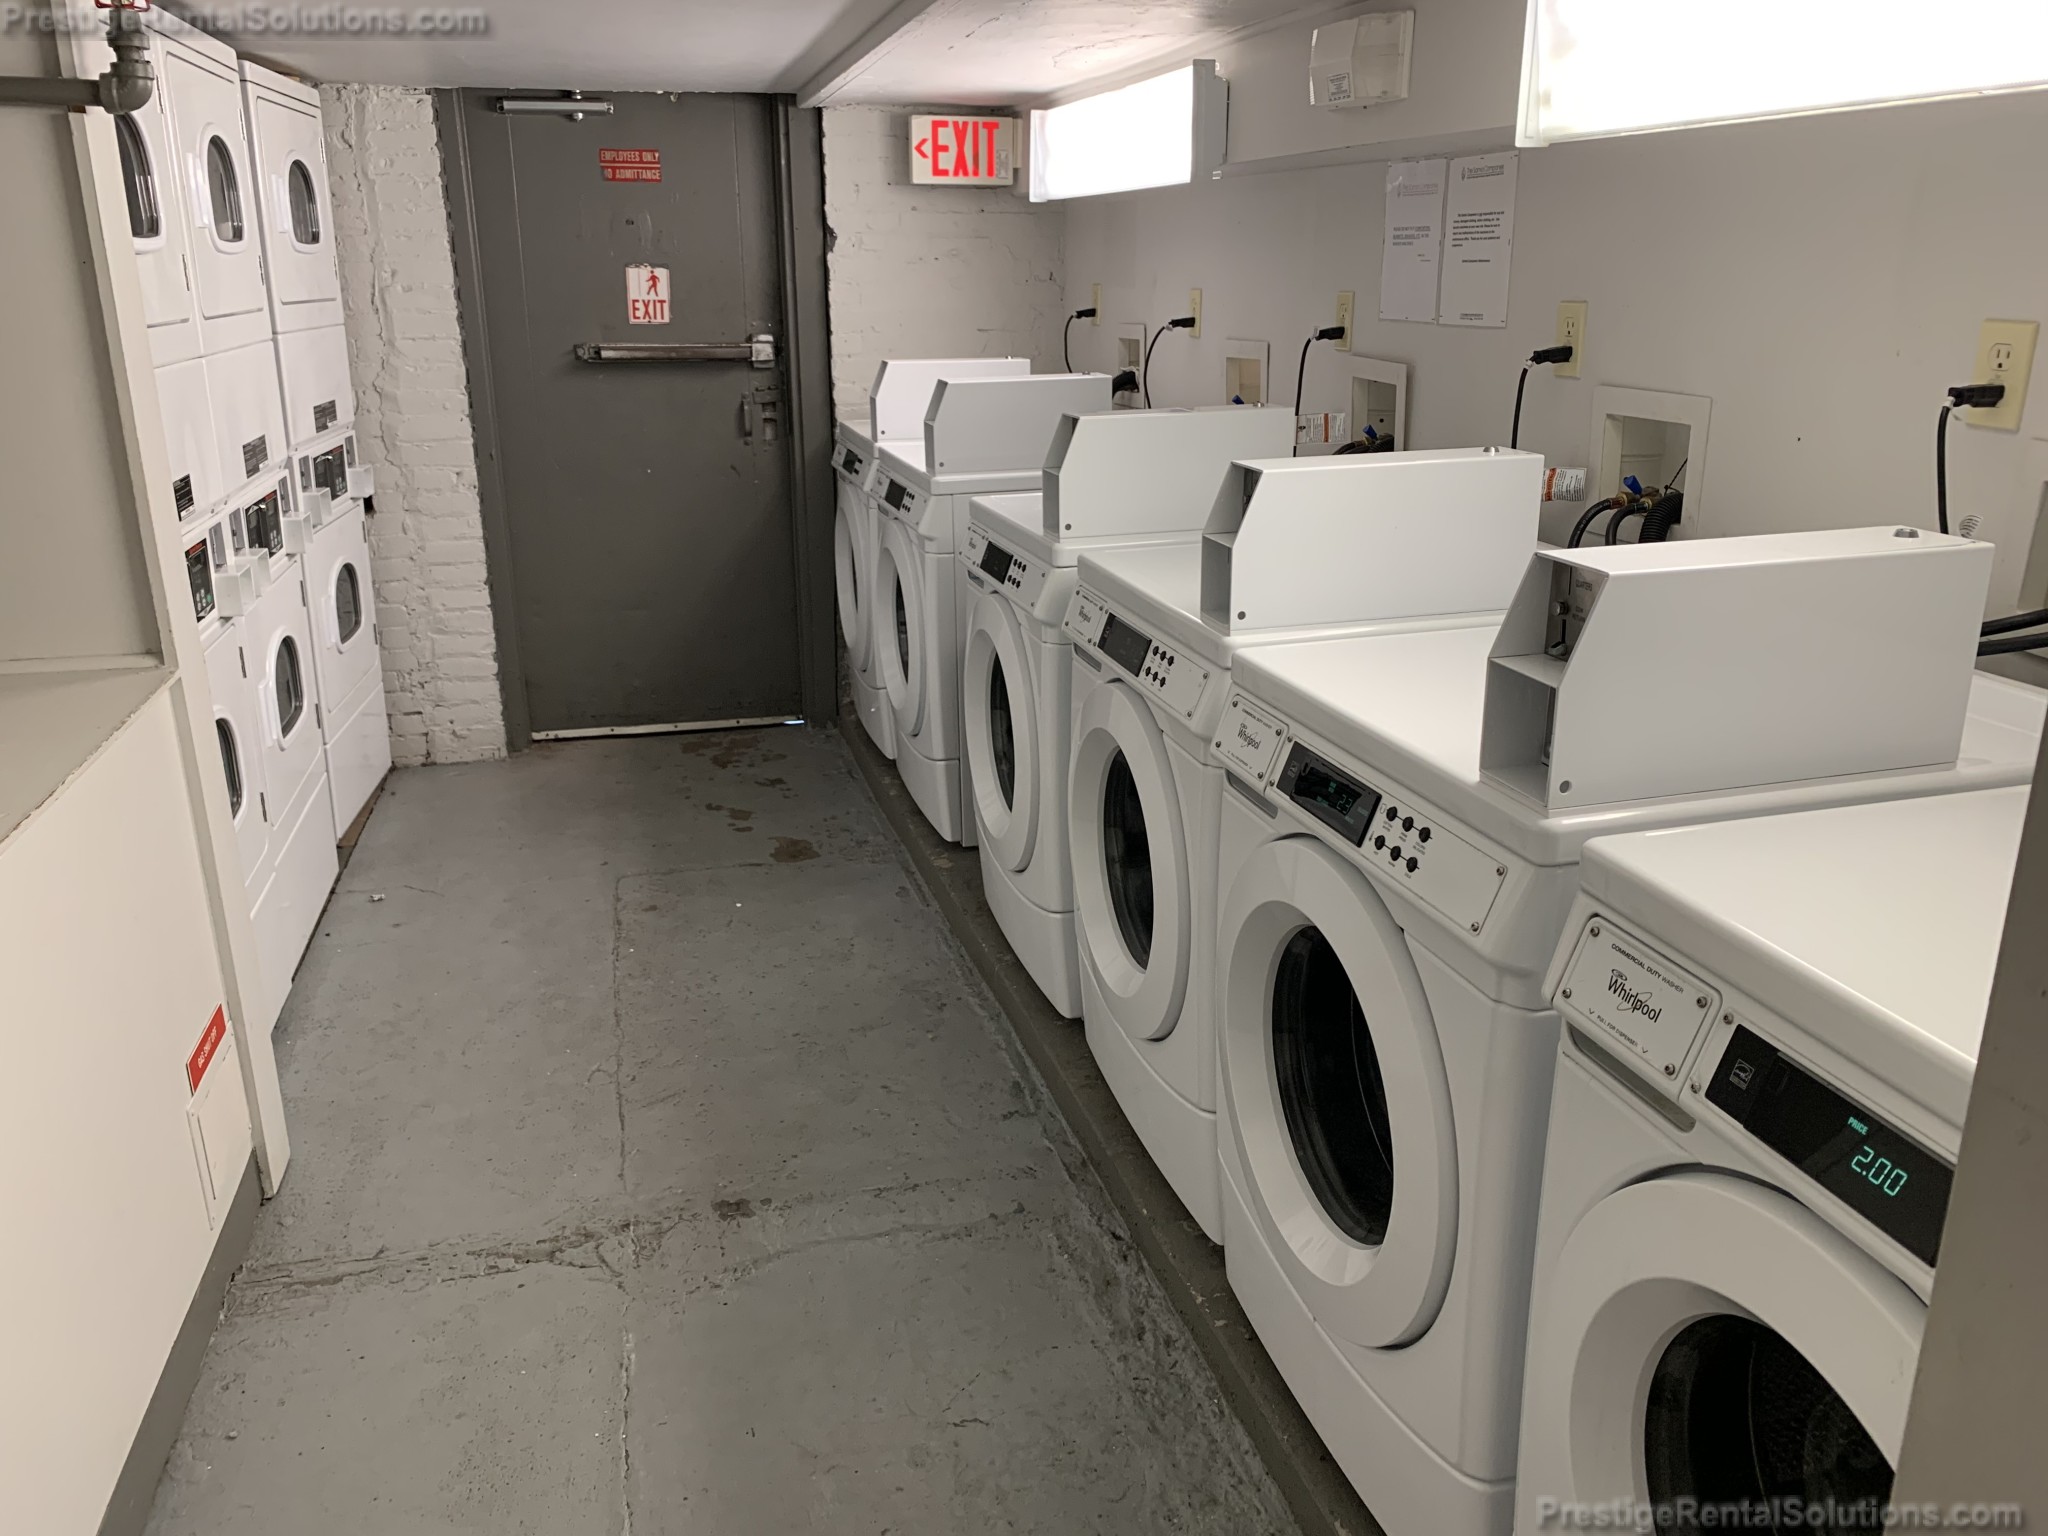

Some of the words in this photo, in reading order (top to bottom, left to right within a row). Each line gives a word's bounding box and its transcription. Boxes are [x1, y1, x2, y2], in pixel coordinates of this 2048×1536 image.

[601, 151, 640, 161] EMPLOYEES
[643, 151, 659, 162] ONLY
[931, 120, 1000, 177] EXIT
[615, 168, 661, 179] ADMITTANCE
[632, 299, 667, 321] EXIT
[1238, 727, 1262, 750] Whirlpool
[1611, 943, 1646, 970] COMMERCIAL
[1646, 965, 1662, 979] DUTY
[1661, 975, 1684, 994] WASHER
[1608, 974, 1663, 1024] Whirlpool
[1847, 1116, 1869, 1136] PRICE
[1851, 1145, 1908, 1196] 2.00
